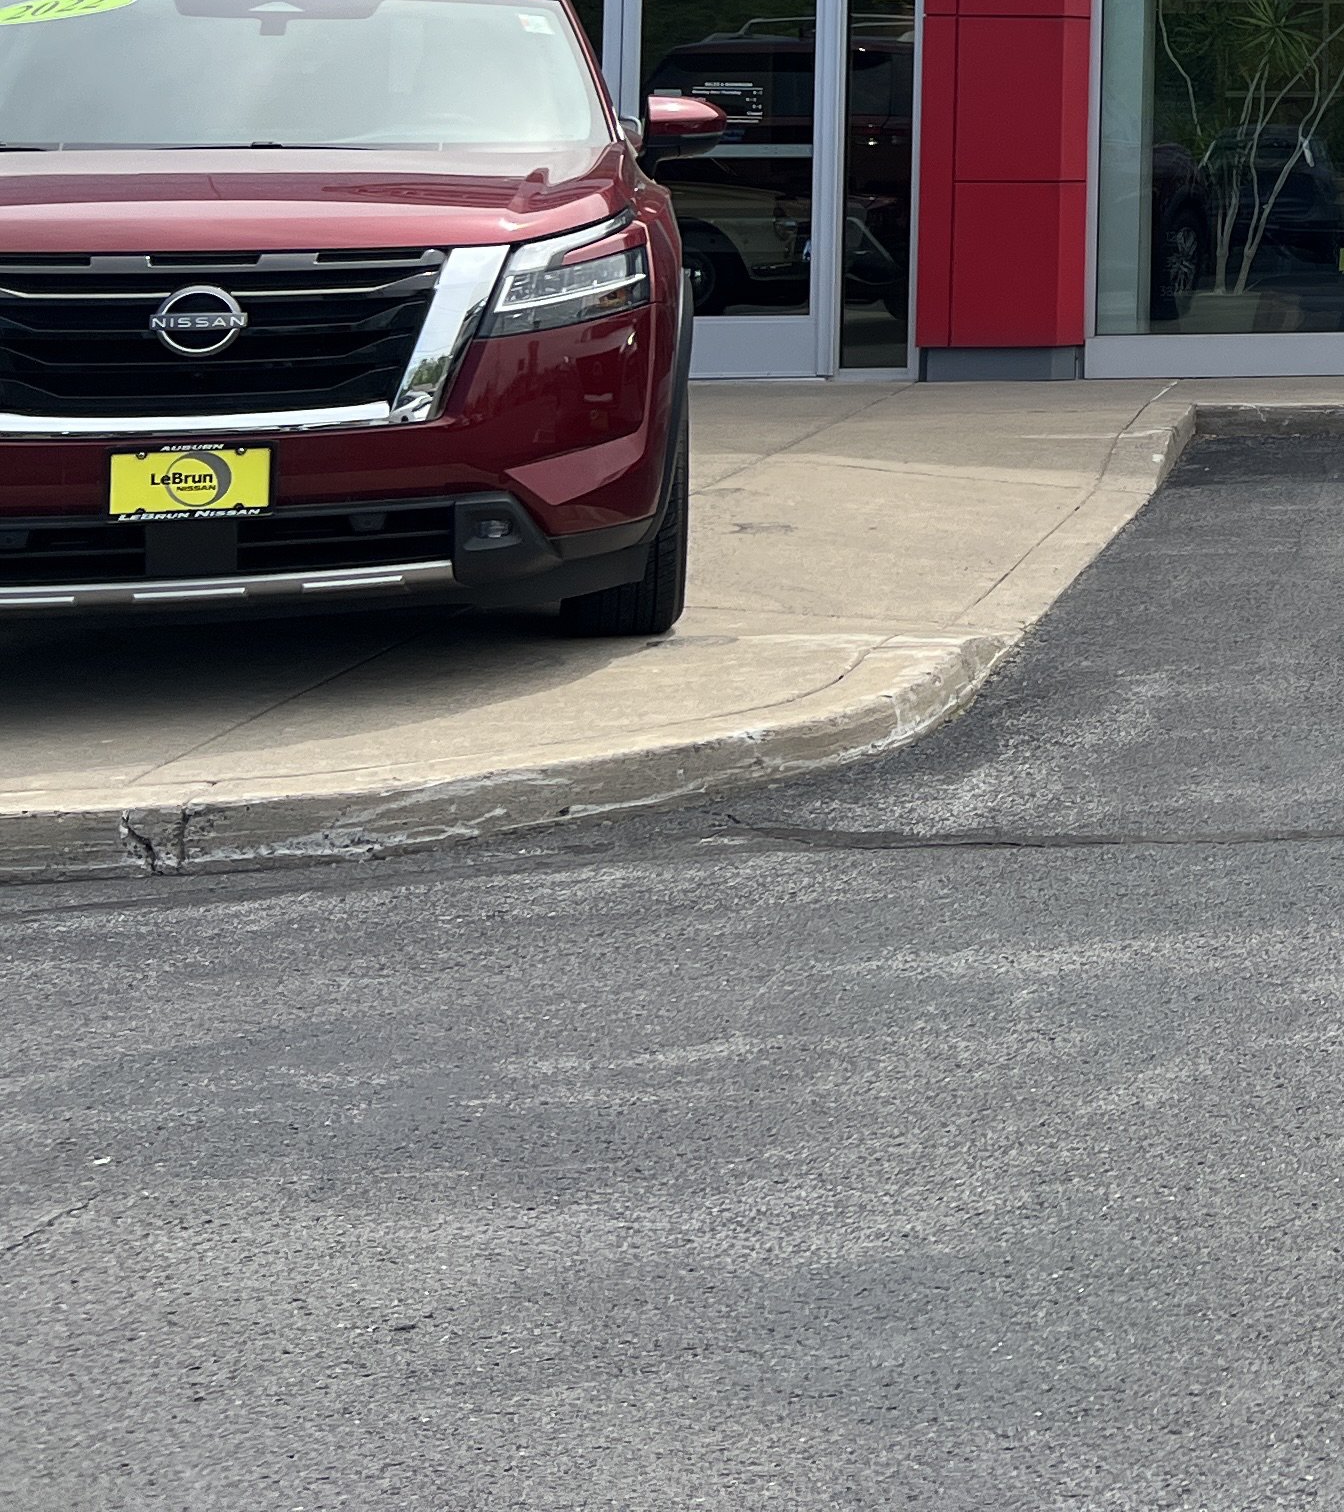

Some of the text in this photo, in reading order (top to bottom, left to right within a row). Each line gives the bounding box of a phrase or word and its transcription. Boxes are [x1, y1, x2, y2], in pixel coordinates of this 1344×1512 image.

[151, 316, 246, 328] NISSAN
[160, 443, 225, 452] AUBURN
[150, 472, 213, 486] LeBrun
[176, 484, 217, 492] NISSAN
